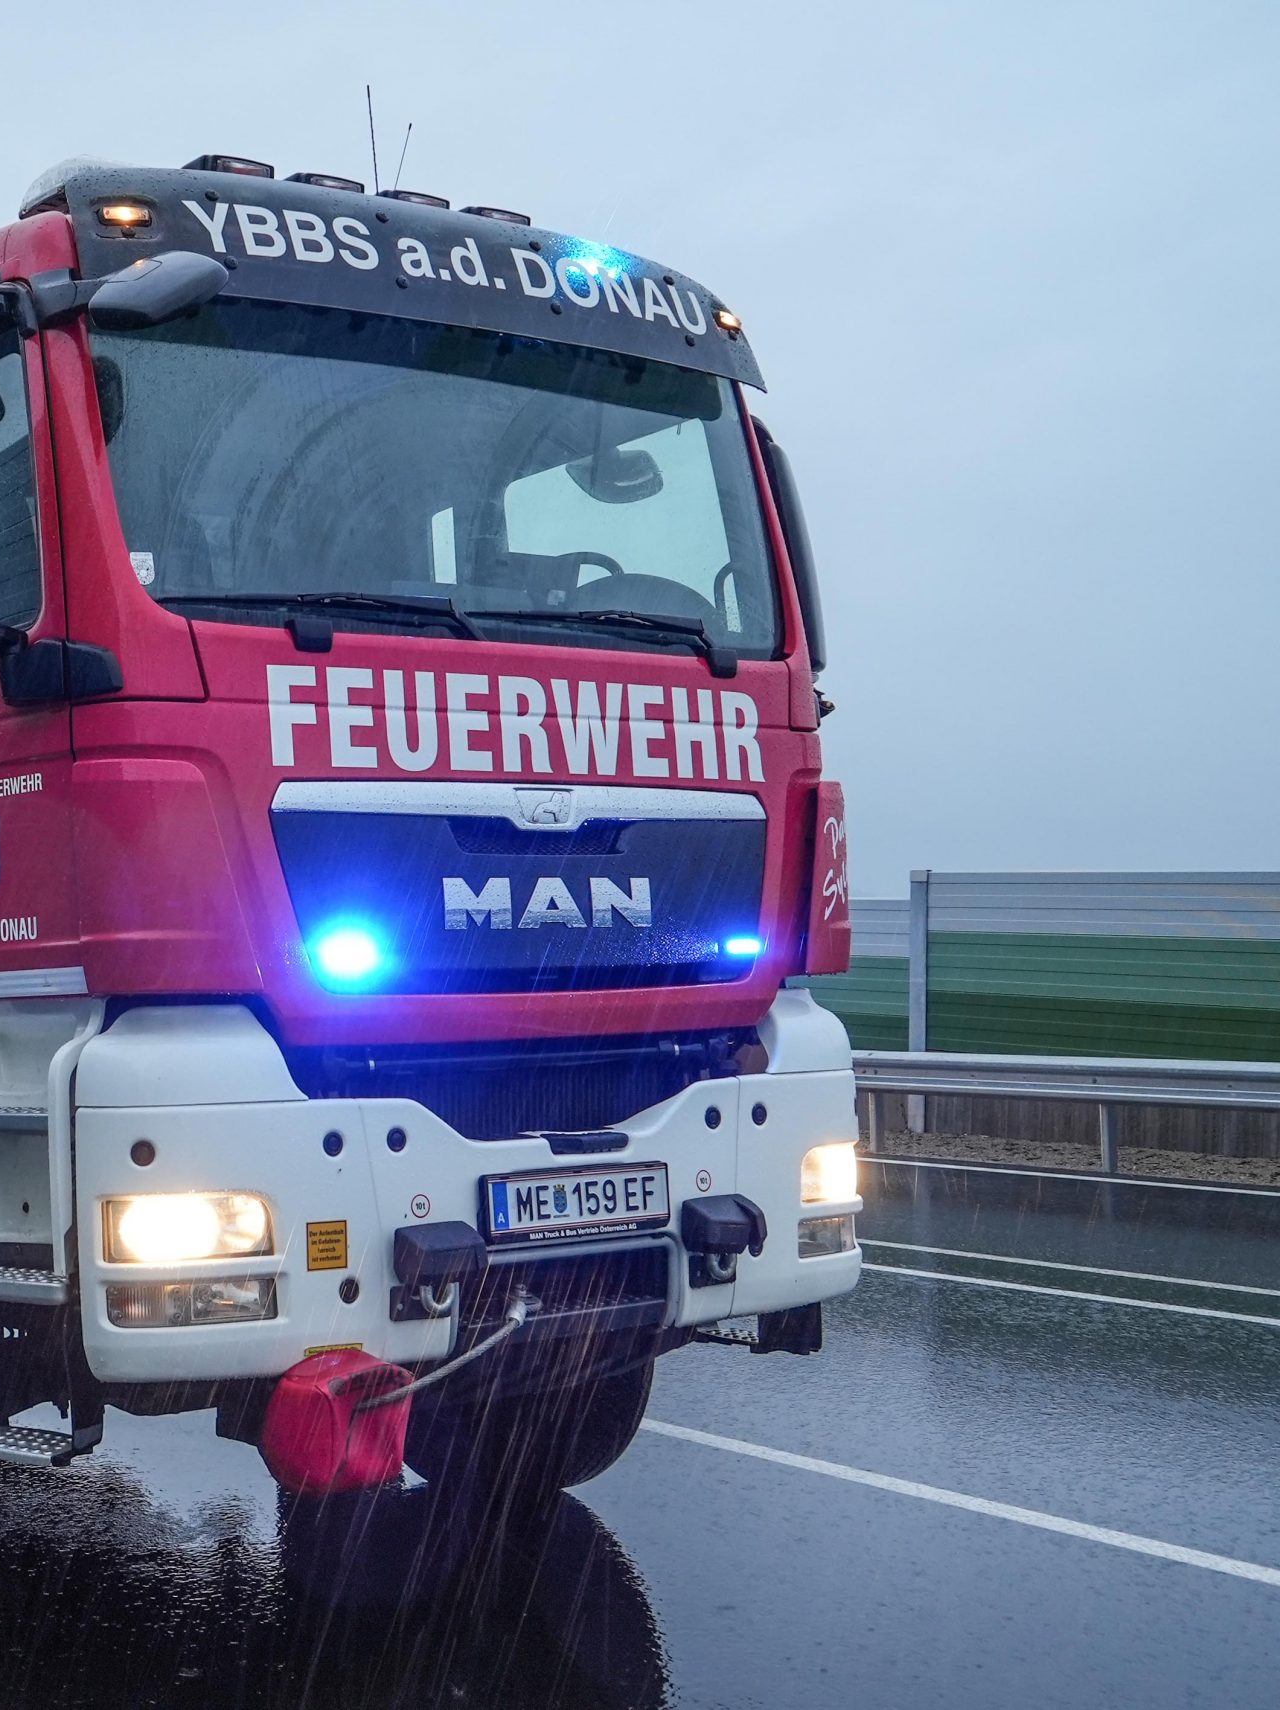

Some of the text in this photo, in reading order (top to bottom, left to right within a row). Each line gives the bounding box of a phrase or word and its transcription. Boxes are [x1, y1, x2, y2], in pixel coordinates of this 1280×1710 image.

[184, 200, 709, 336] YBBS a.d. DONAU
[266, 665, 766, 783] FEUERWEHR
[442, 877, 652, 930] MAN
[497, 1212, 506, 1224] A
[516, 1176, 655, 1222] ME 159 EF
[577, 1227, 600, 1235] Vertrieb
[628, 1222, 637, 1230] AG
